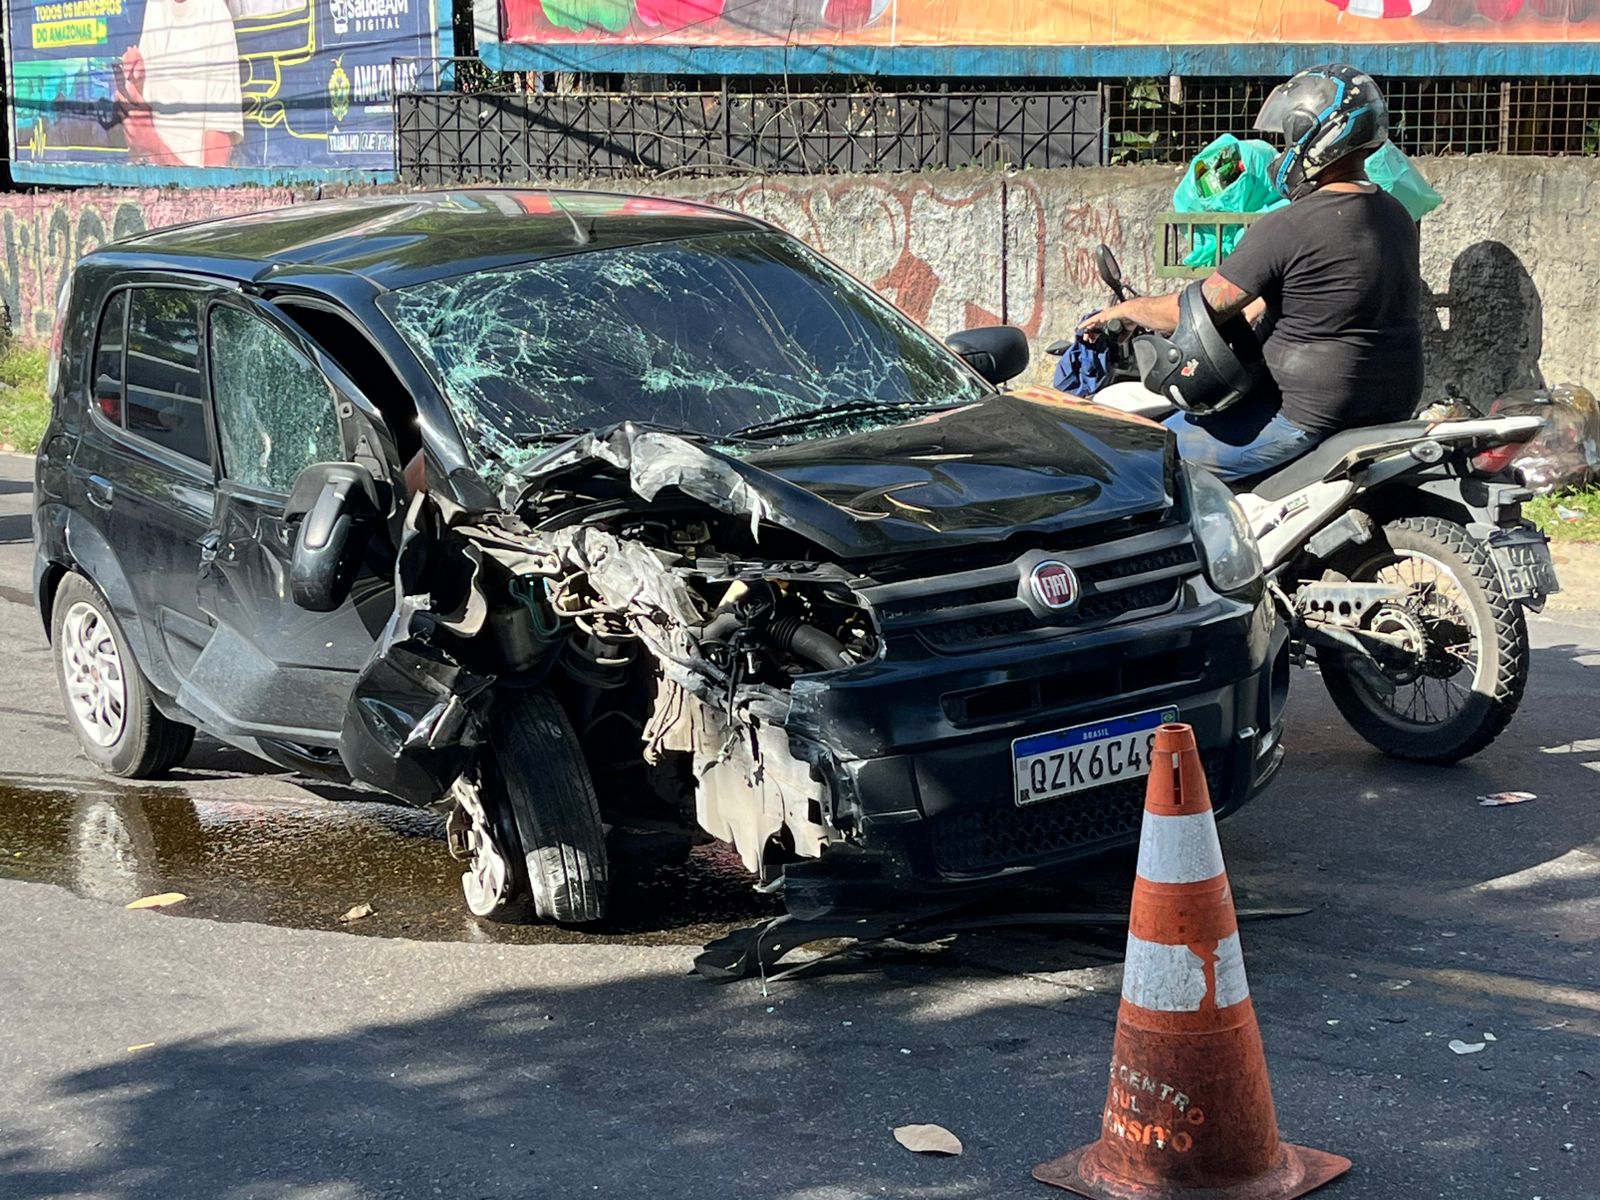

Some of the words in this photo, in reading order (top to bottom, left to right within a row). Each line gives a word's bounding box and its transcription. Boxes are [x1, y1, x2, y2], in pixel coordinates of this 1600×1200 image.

[35, 3, 62, 21] TODOS
[36, 28, 48, 43] DO
[49, 24, 92, 41] AMAZONAS
[355, 17, 400, 33] DIGITAL
[354, 63, 418, 102] AMAZONAS
[1041, 573, 1069, 599] FIAT
[1083, 728, 1109, 741] BRASIL
[1020, 788, 1030, 802] BR
[1112, 1086, 1142, 1113] SUL
